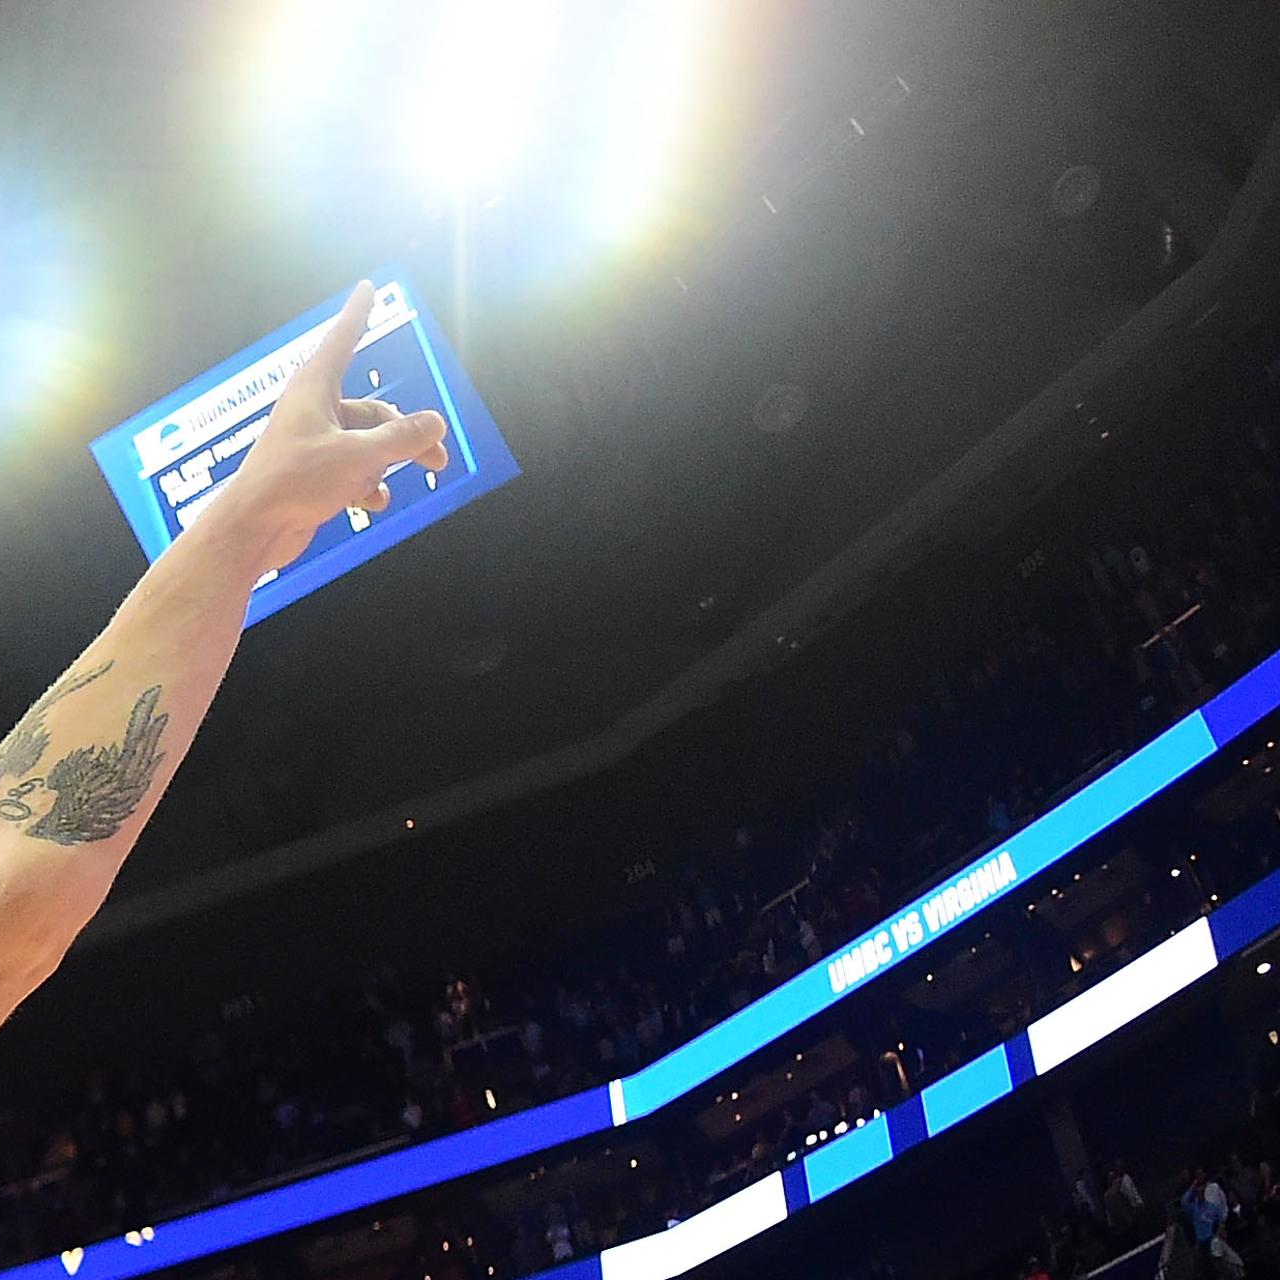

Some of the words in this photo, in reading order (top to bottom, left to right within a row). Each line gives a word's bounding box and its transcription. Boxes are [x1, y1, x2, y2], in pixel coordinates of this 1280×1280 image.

[827, 931, 894, 994] UMBC
[890, 910, 925, 954] VS
[922, 850, 1019, 934] VIRGINIA
